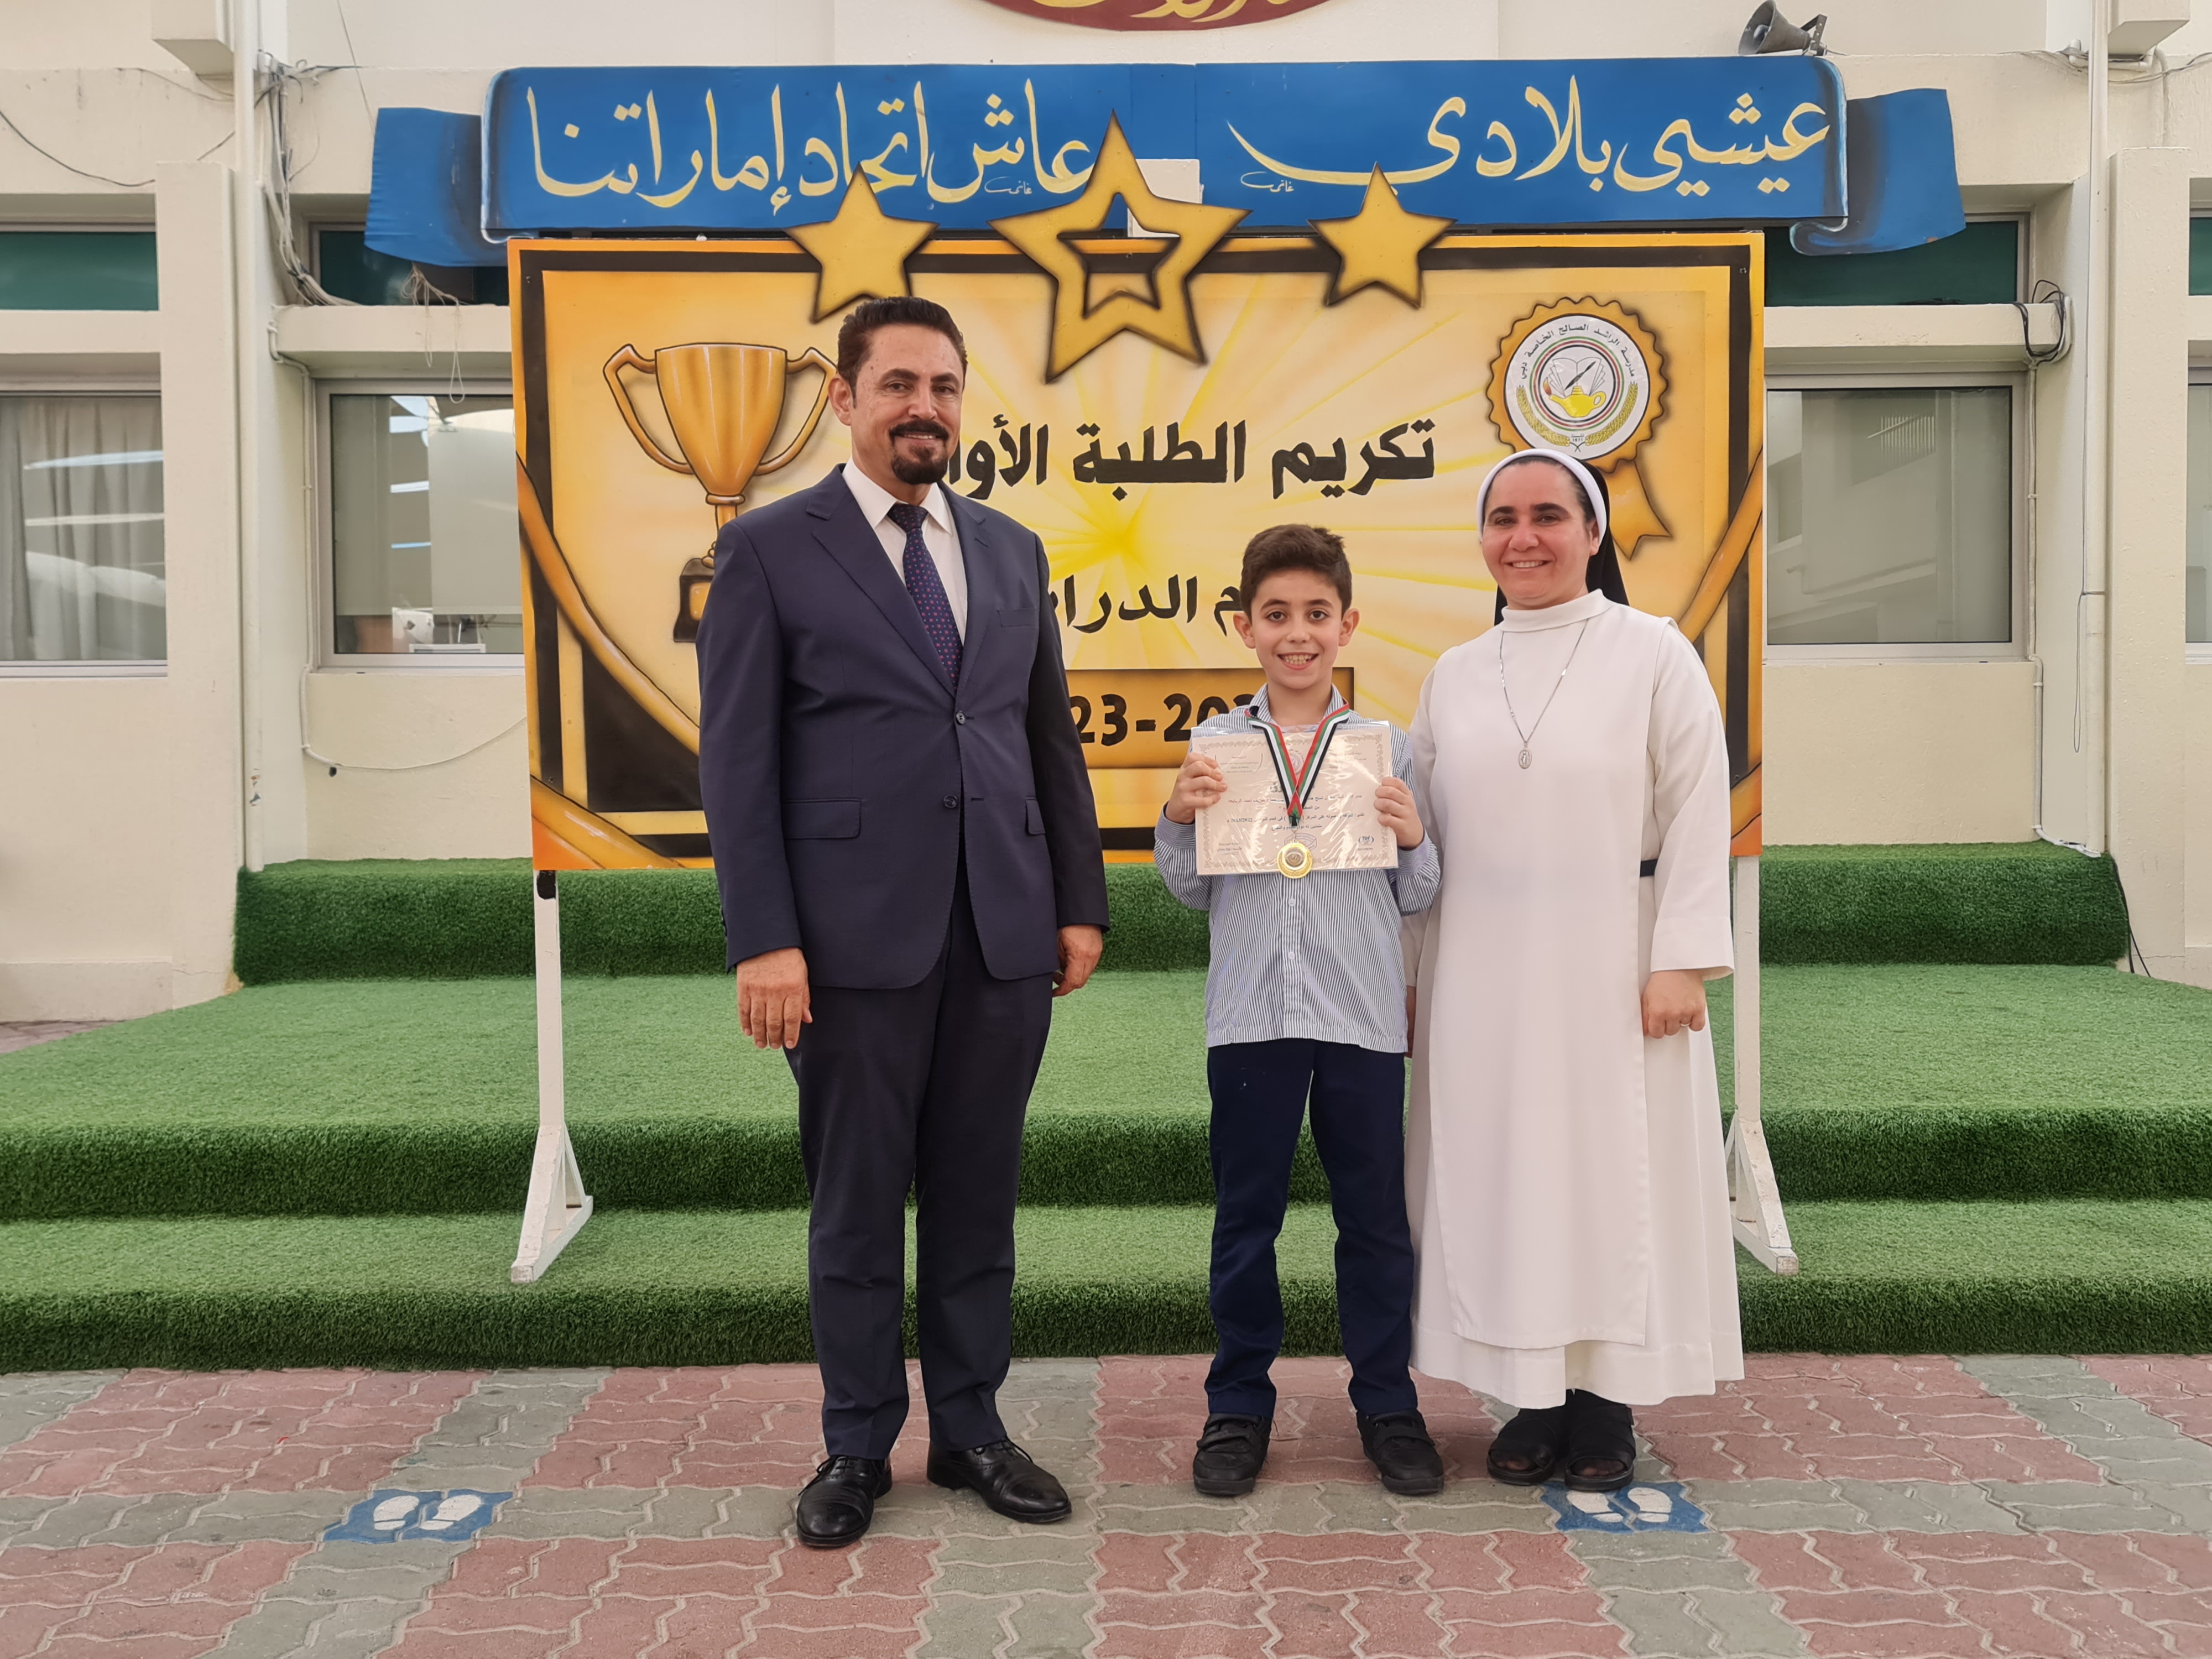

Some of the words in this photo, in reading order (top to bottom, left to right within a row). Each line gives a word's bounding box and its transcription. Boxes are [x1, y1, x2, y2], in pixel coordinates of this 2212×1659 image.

[927, 79, 1094, 204] عاش
[1614, 93, 1830, 197] عيشي
[1524, 330, 1554, 358] الخاصة
[1558, 323, 1589, 336] الصالح
[1593, 328, 1621, 346] الراشد
[1620, 346, 1635, 377] مدرسة
[948, 414, 1049, 500] الأوا
[1073, 419, 1246, 501] الطلبة
[1272, 418, 1435, 499] تكريم
[1051, 573, 1198, 634] الدرا
